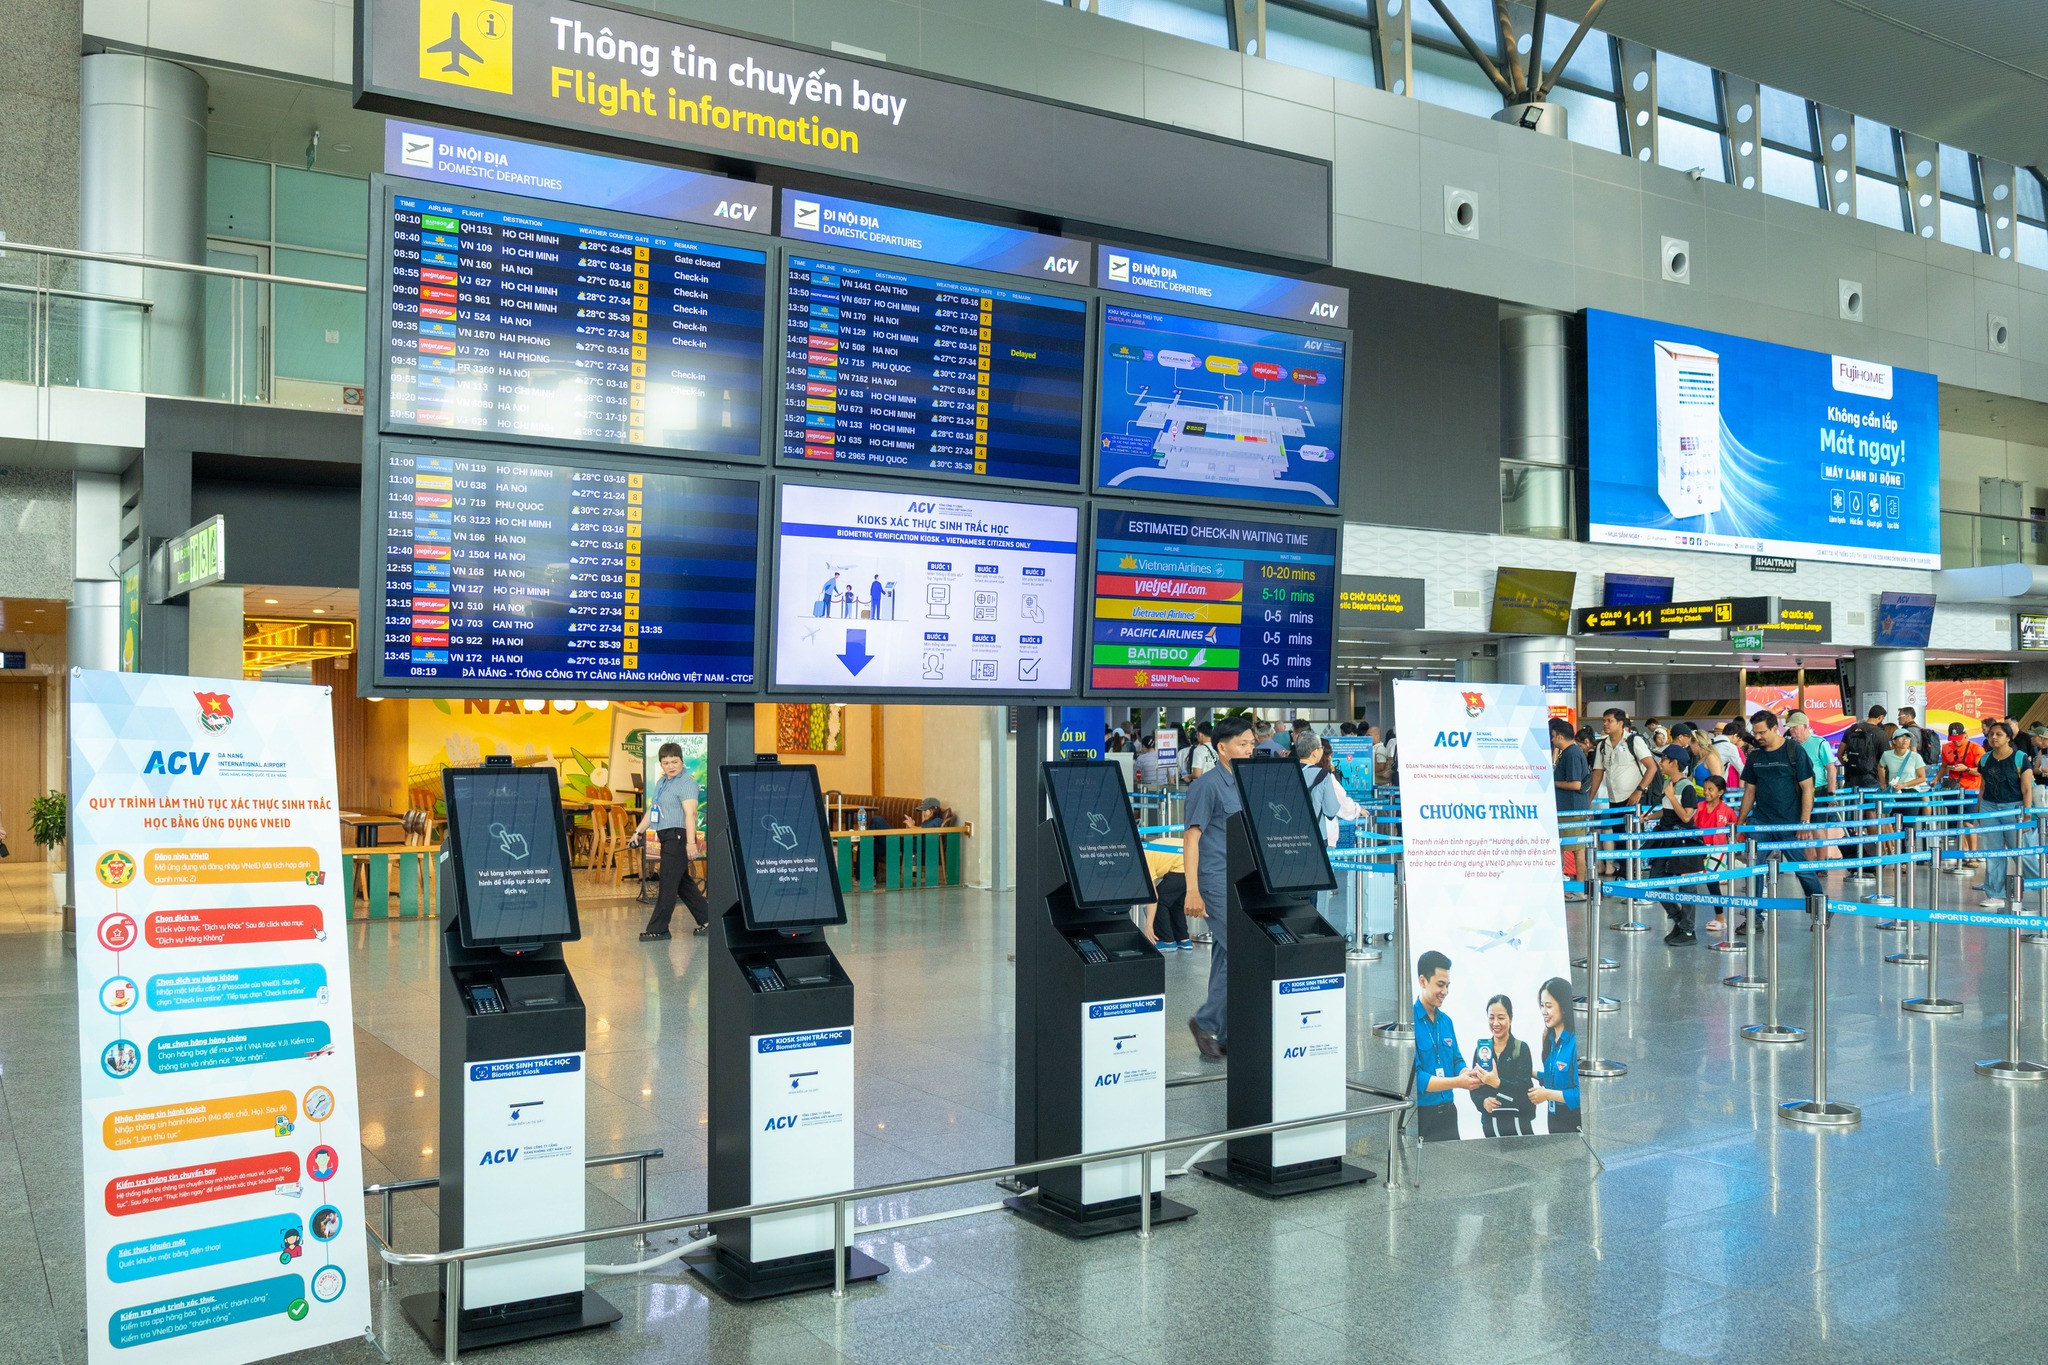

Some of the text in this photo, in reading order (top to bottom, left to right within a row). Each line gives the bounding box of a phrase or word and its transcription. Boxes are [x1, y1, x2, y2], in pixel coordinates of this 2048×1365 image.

[551, 16, 907, 126] Thông tin chuyến bay
[551, 66, 859, 154] Flight information
[438, 144, 508, 167] ĐI NỘI ĐỊA
[439, 161, 562, 190] DOMESTIC DEPARTURES
[713, 201, 757, 221] ACV
[824, 209, 879, 229] ĐI NỘI ĐỊA
[395, 213, 420, 224] 08:10
[461, 223, 476, 232] QH
[477, 226, 492, 235] 151
[502, 229, 516, 238] HO
[519, 232, 535, 241] CHI
[536, 234, 559, 245] MINH
[610, 245, 632, 256] 43-45
[675, 255, 693, 265] Gate
[695, 258, 720, 269] closed
[824, 225, 922, 249] DOMESTIC DEPARTURES
[1044, 256, 1079, 274] ACV
[1132, 263, 1177, 280] ĐI NỘI ĐỊA
[1132, 276, 1212, 296] DOMESTIC DEPARTURES
[1310, 302, 1339, 318] ACV
[1011, 349, 1036, 359] Delayed
[1828, 406, 1897, 433] Không cần lắp
[1820, 427, 1905, 466] Mát ngay!
[1826, 465, 1900, 486] MÁY LẠNH DI ĐỘNG
[908, 502, 935, 513] ACV
[857, 515, 1009, 536] KIOKS XÁC THỰC SINH TRẮC HỌC
[1129, 521, 1308, 545] ESTIMATED CHECK-IN WAITING TIME
[837, 530, 872, 538] BIOMETRIC
[875, 532, 918, 541] VERIFICATION
[946, 537, 985, 546] VIETNAMESE
[1139, 559, 1211, 574] Vietnam Airlines
[1261, 566, 1315, 581] 10-20 mins
[1262, 588, 1314, 602] 5-10 mins
[1132, 607, 1195, 620] Vietravel Airlines
[1265, 610, 1313, 624] 0-5 mins
[386, 617, 411, 625] 13:20
[451, 619, 463, 627] VJ
[467, 620, 483, 628] 703
[492, 621, 512, 629] CAN
[599, 624, 621, 632] 27-34
[640, 626, 662, 634] 13:35
[1120, 628, 1203, 639] PACIFIC AIRLINES
[1264, 632, 1312, 645] 0-5 mins
[1128, 648, 1188, 660] BAMBOO
[1262, 654, 1311, 666] 0-5 mins
[411, 668, 437, 676] 08:19
[515, 667, 542, 678] TỔNG
[545, 668, 573, 679] CÔNG
[576, 671, 587, 679] TY
[590, 670, 616, 680] CẢNG
[619, 670, 645, 680] HÀNG
[648, 671, 680, 681] KHÔNG
[683, 673, 702, 683] VIỆT
[705, 674, 724, 682] NAM
[1261, 676, 1310, 688] 0-5 mins
[1434, 731, 1472, 747] ACV
[144, 751, 210, 775] ACV
[89, 795, 331, 812] QUY TRÌNH LÀM THỦ TỤC XÁC THỰC SINH TRẮC
[1420, 800, 1538, 819] CHƯƠNG TRÌNH
[144, 813, 291, 830] HỌC BẰNG ỨNG DỤNG VNEID
[1645, 890, 1758, 907] AIRPORTS CORPORATION OF VIETNAM
[554, 1058, 570, 1066] HỌC
[491, 1070, 522, 1078] Biometric
[480, 1148, 519, 1166] ACV
